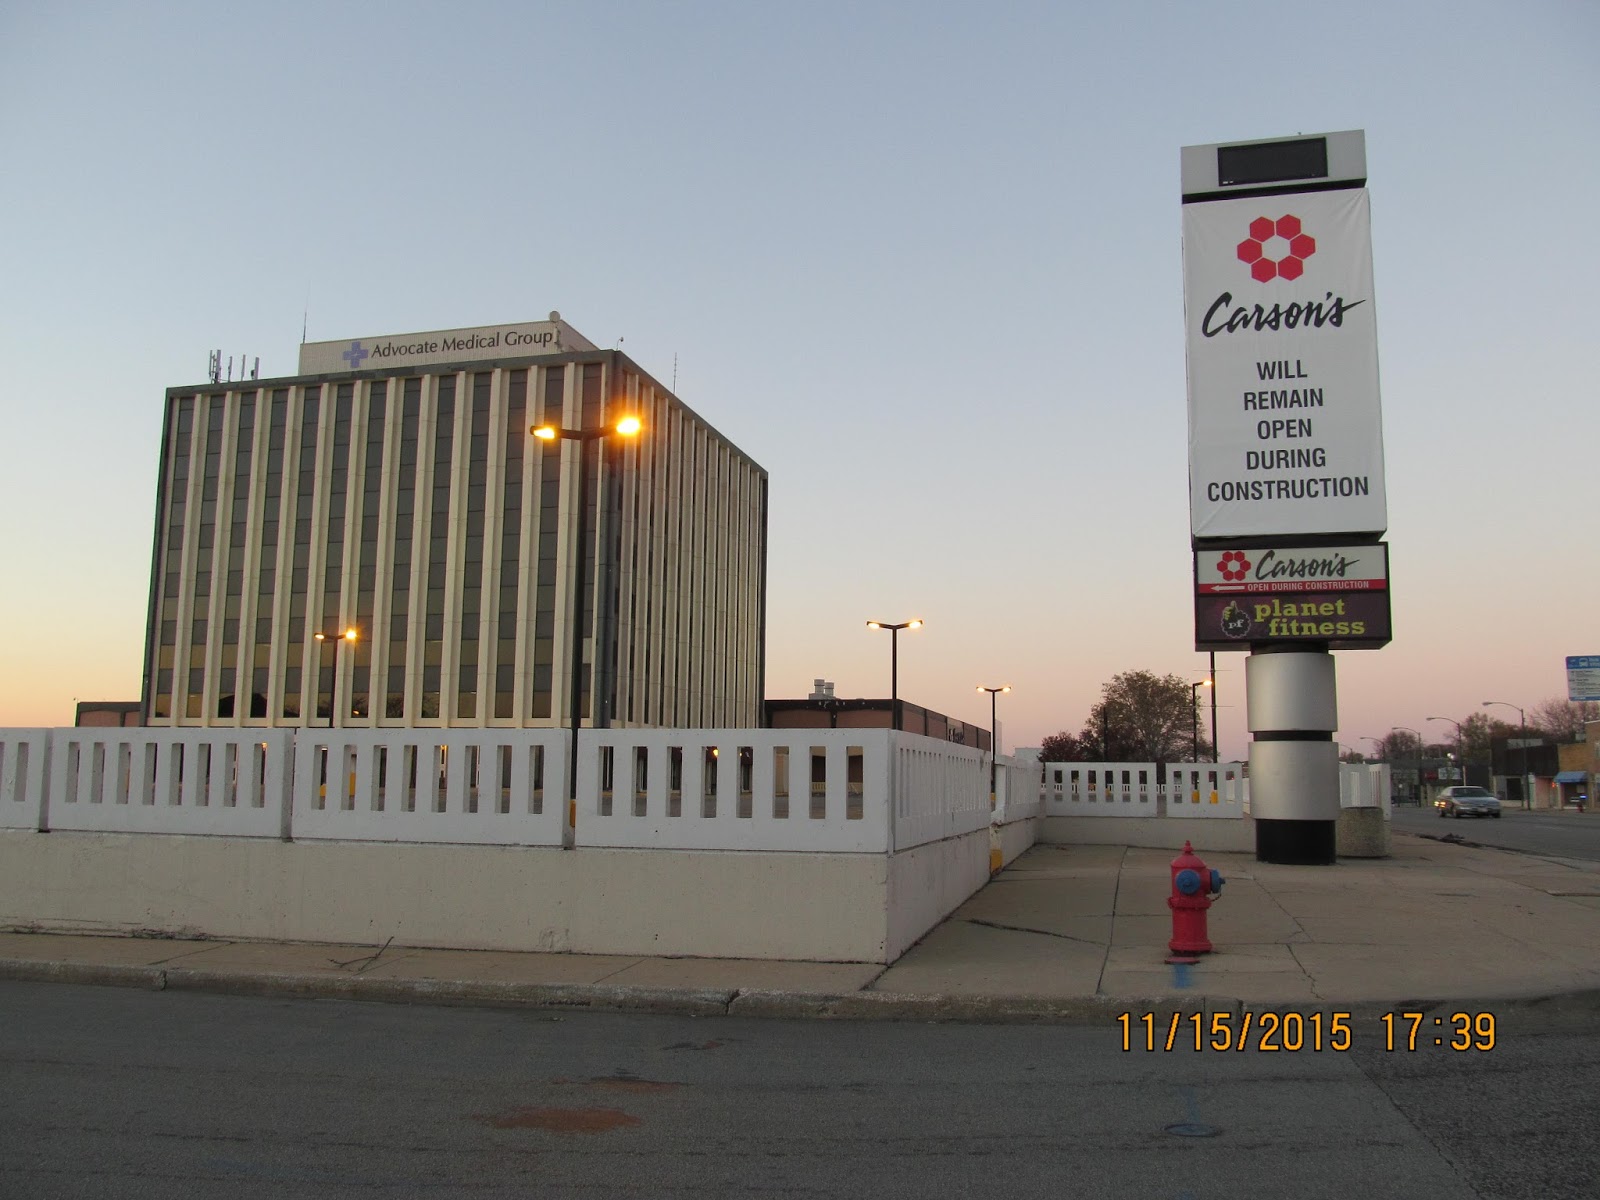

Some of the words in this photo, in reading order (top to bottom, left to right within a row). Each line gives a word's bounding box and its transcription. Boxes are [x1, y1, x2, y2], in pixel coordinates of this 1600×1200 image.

[1202, 291, 1366, 338] Carson's
[371, 340, 438, 358] Advocate
[441, 332, 500, 352] Medical
[505, 330, 553, 346] Group
[1256, 359, 1308, 381] WILL
[1243, 388, 1324, 411] REMAIN
[1257, 418, 1312, 440] OPEN
[1246, 447, 1326, 470] DURING
[1207, 476, 1369, 502] CONSTRUCTION
[1255, 549, 1360, 581] Carson's
[1247, 583, 1270, 592] OPEN
[1271, 582, 1303, 591] DURING
[1305, 580, 1369, 590] CONSTRUCTION
[1254, 598, 1346, 622] planet
[1228, 618, 1245, 630] pf
[1268, 618, 1366, 637] fitness
